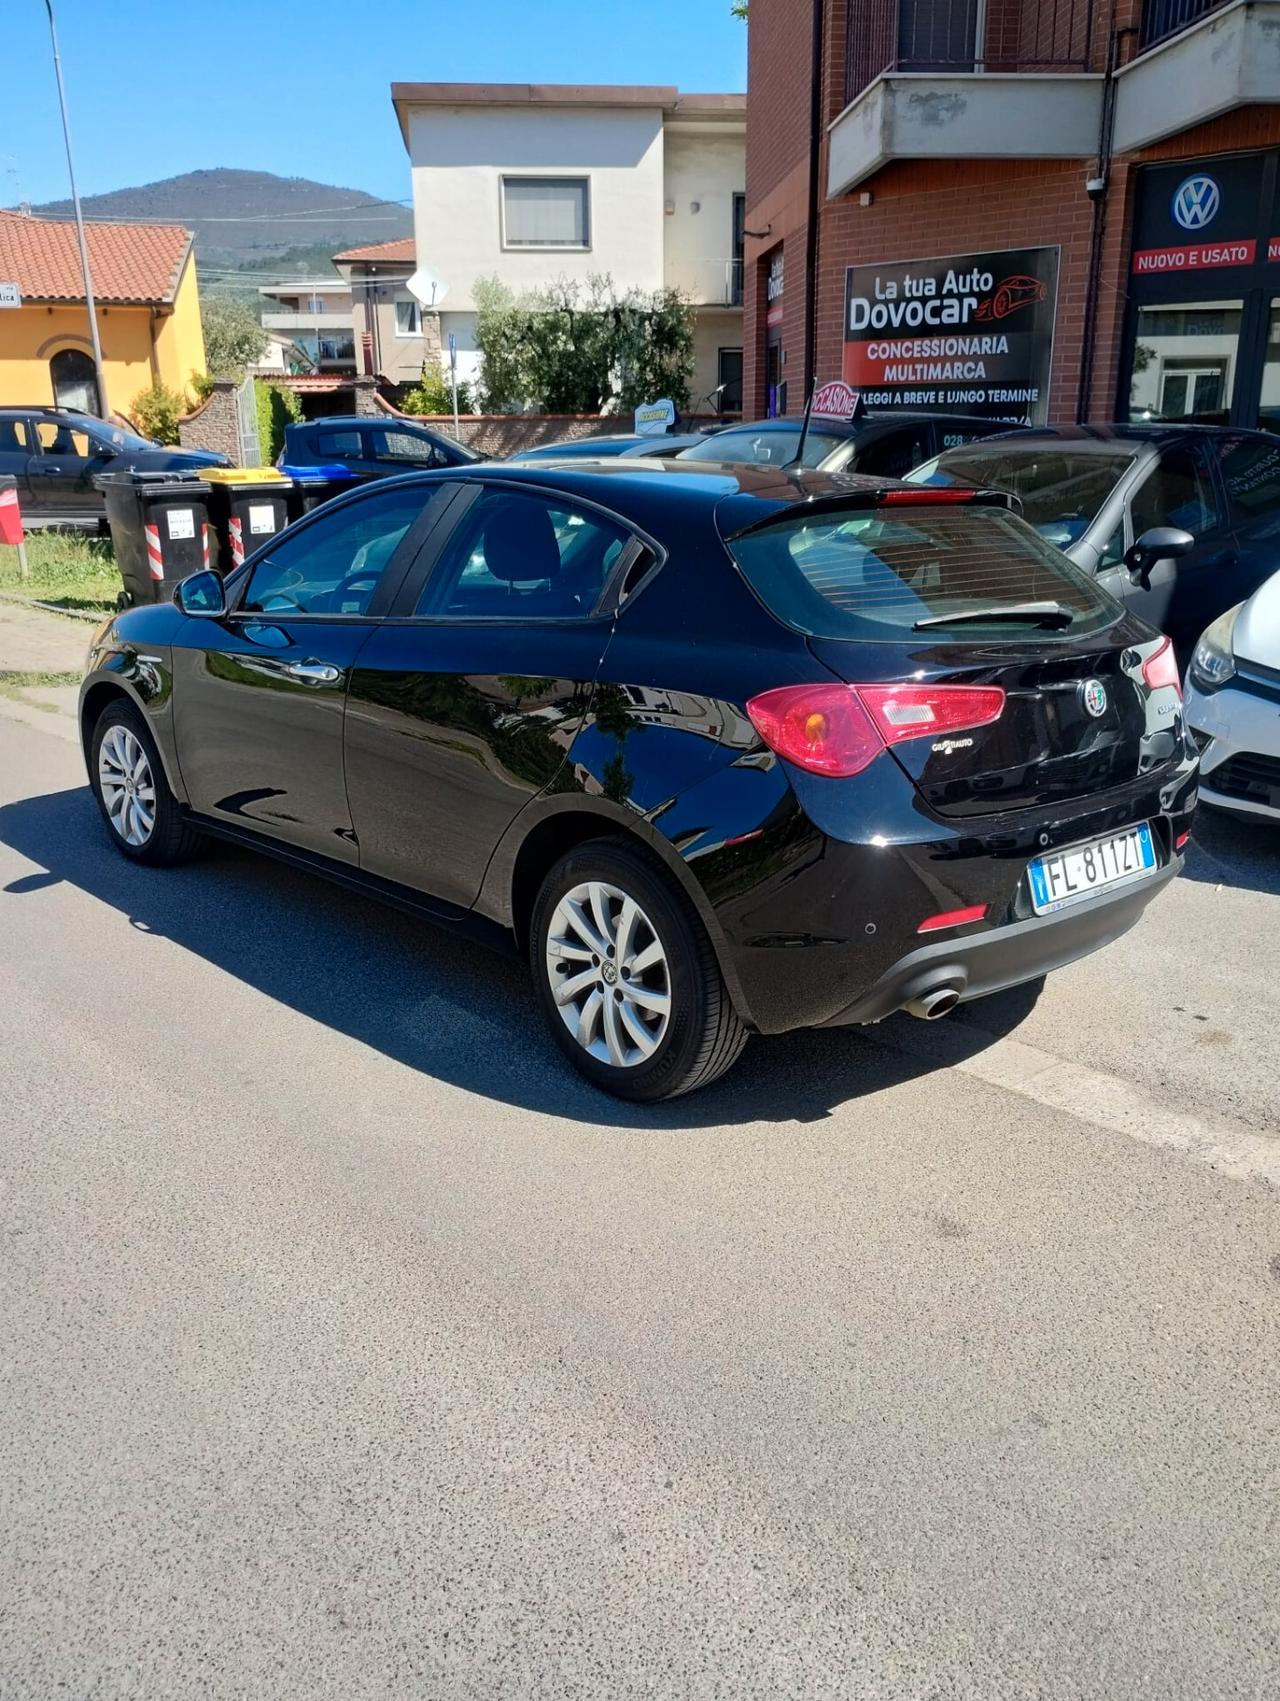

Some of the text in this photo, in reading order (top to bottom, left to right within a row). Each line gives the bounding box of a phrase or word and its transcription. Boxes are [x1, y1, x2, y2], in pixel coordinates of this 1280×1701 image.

[1138, 247, 1247, 270] NUOVO E USATO
[875, 267, 993, 299] La tua Auto
[850, 297, 978, 330] Dovocar
[867, 335, 1009, 360] CONCESSIONARIA
[884, 361, 986, 382] MULTIMARCA
[861, 388, 1039, 405] LEGGI A BREVE E LUNGO TERMINE
